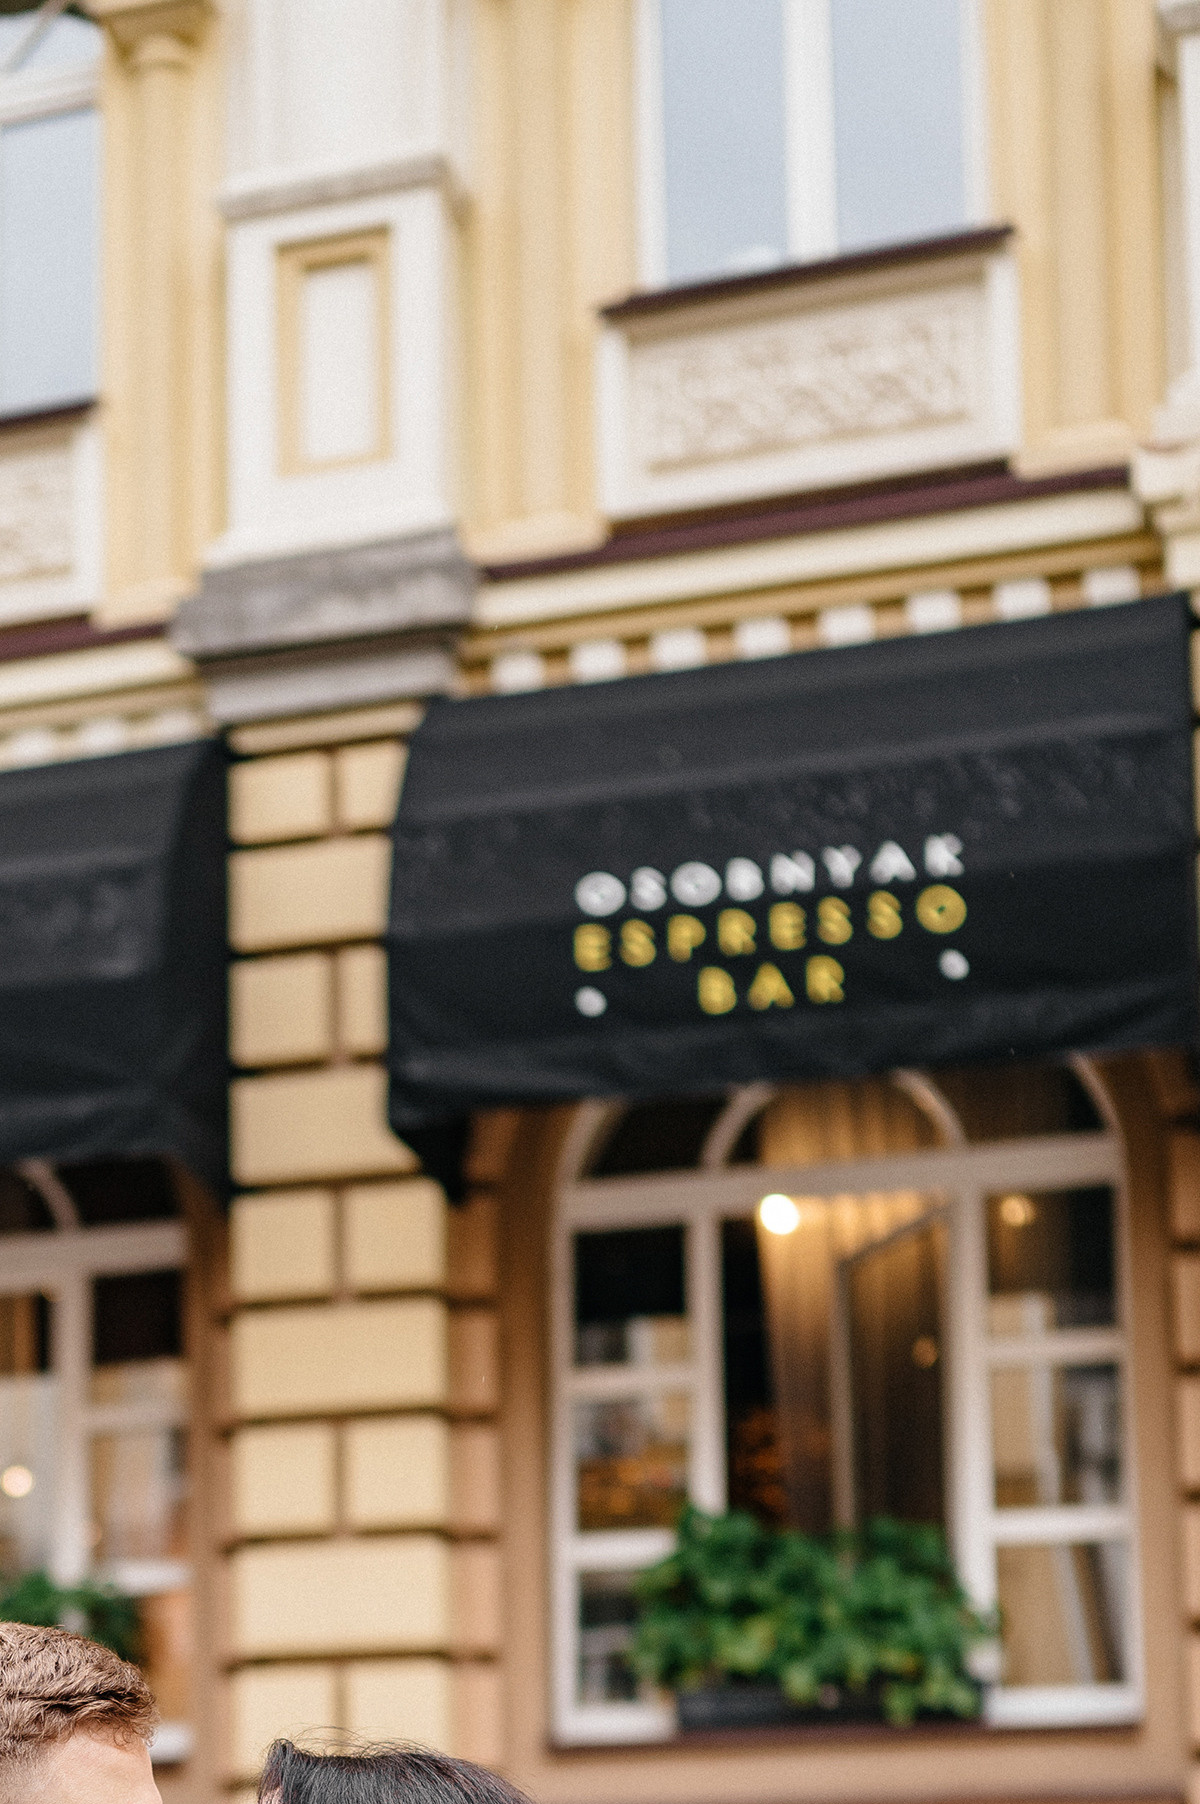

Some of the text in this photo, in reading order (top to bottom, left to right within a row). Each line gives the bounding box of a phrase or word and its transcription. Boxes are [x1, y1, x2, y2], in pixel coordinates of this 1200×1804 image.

[574, 832, 964, 917] OSOBNYAK
[573, 884, 967, 973] ESPRESSO
[697, 955, 845, 1015] BAR
